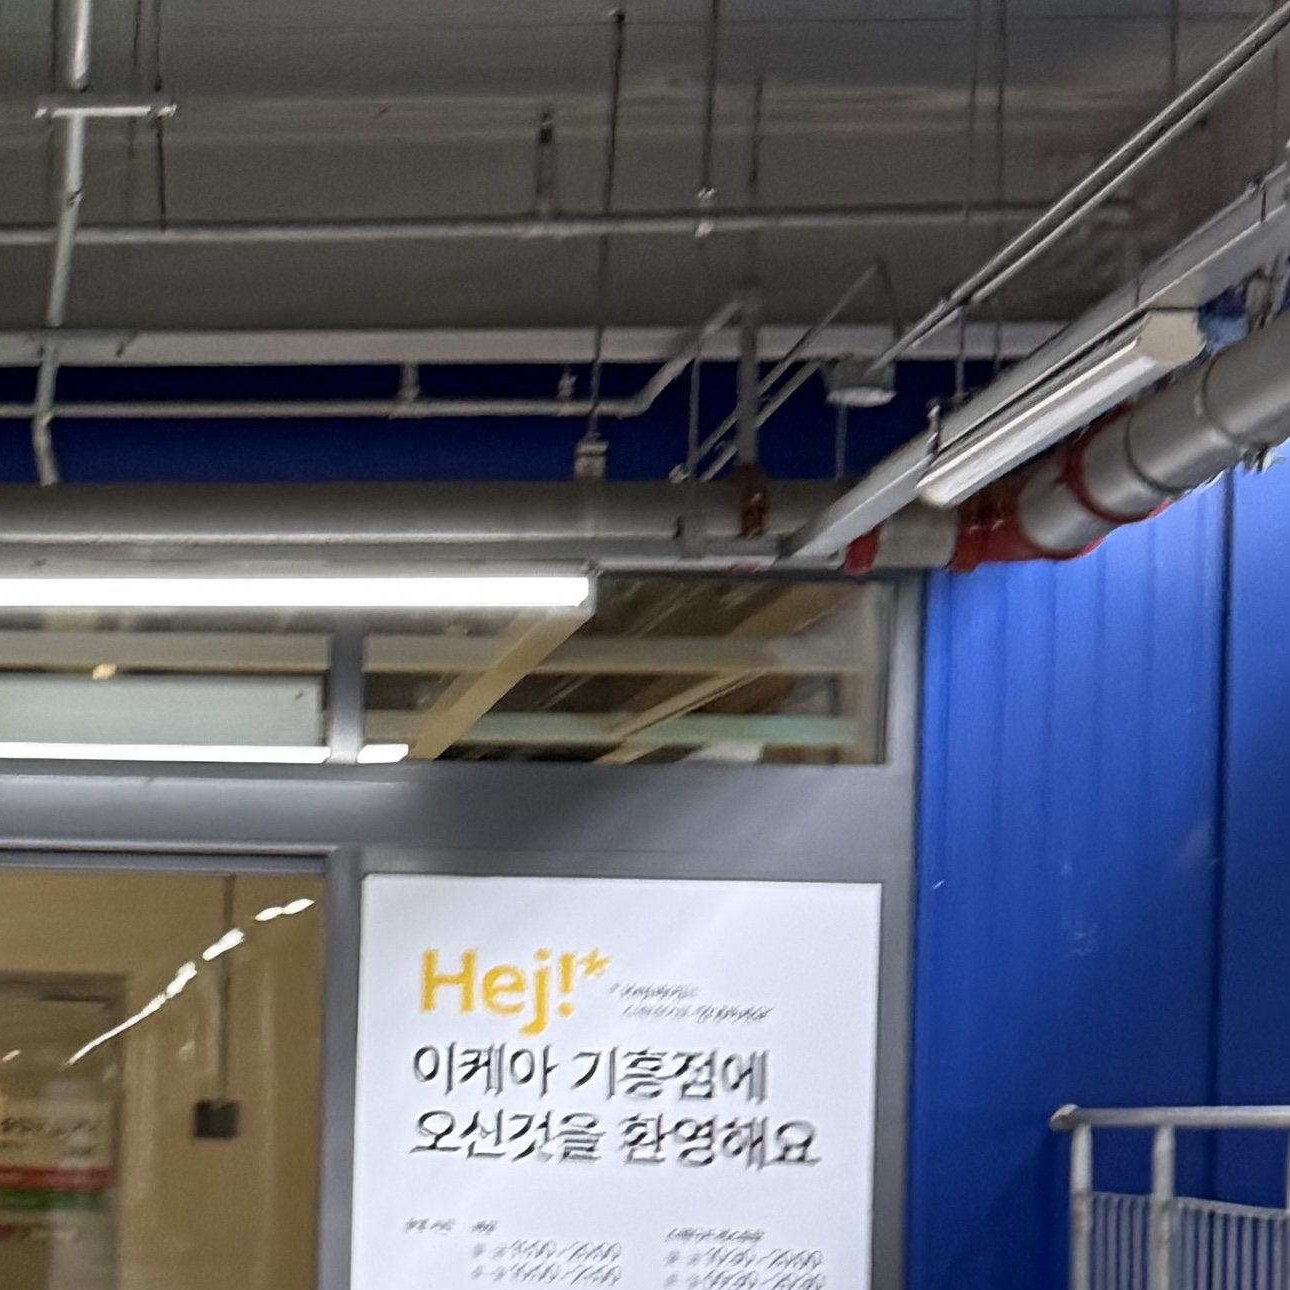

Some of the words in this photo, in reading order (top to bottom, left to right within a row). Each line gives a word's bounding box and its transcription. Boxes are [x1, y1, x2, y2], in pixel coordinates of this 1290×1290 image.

[413, 1042, 559, 1099] 이케아
[571, 1046, 770, 1105] 기흥점에
[410, 1108, 606, 1164] 오신것을
[617, 1111, 822, 1170] 환영해요
